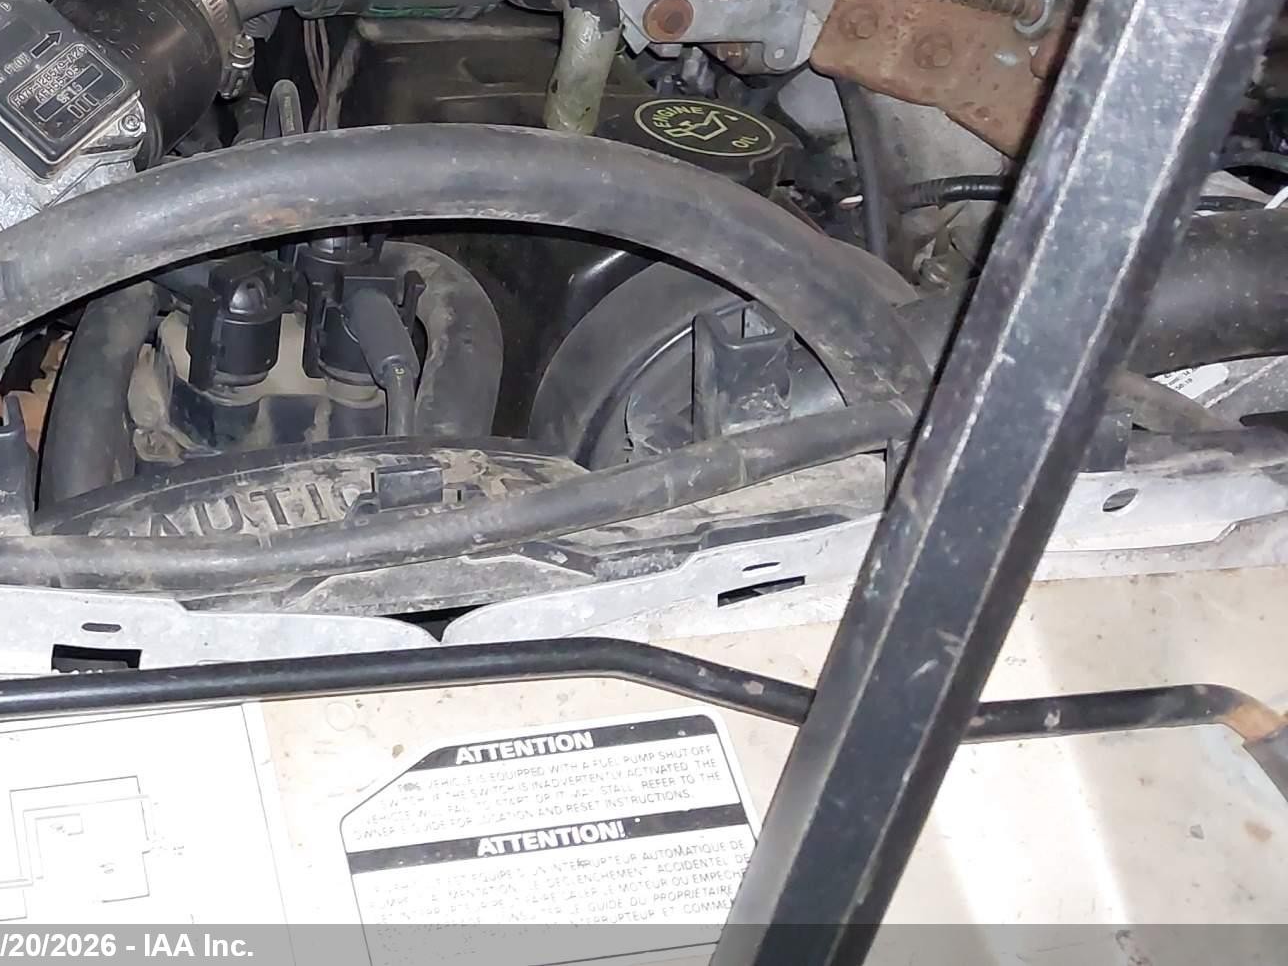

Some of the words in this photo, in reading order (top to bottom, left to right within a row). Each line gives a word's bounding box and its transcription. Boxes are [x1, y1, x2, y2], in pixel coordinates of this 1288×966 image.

[653, 105, 705, 128] ENGINE
[731, 135, 759, 149] OIL
[455, 731, 594, 765] ATTENTION
[397, 781, 421, 793] TS
[489, 765, 544, 781] EQUIPPED
[623, 752, 655, 764] PUMP
[658, 747, 688, 760] SHUT
[690, 744, 711, 756] OFF
[627, 761, 688, 777] ACTIVATED
[694, 758, 716, 769] THE
[641, 776, 676, 790] REFER
[680, 774, 695, 785] TO
[700, 771, 720, 782] THE
[537, 805, 562, 817] AND
[566, 800, 599, 813] RESET
[477, 820, 626, 857] ATTENTION!
[642, 841, 725, 861] AUTOMATIQUE
[729, 839, 745, 850] DE
[656, 856, 728, 874] ACCIDENTEL
[671, 875, 688, 887] OU
[586, 897, 622, 911] GUIDE
[629, 894, 646, 906] DU
